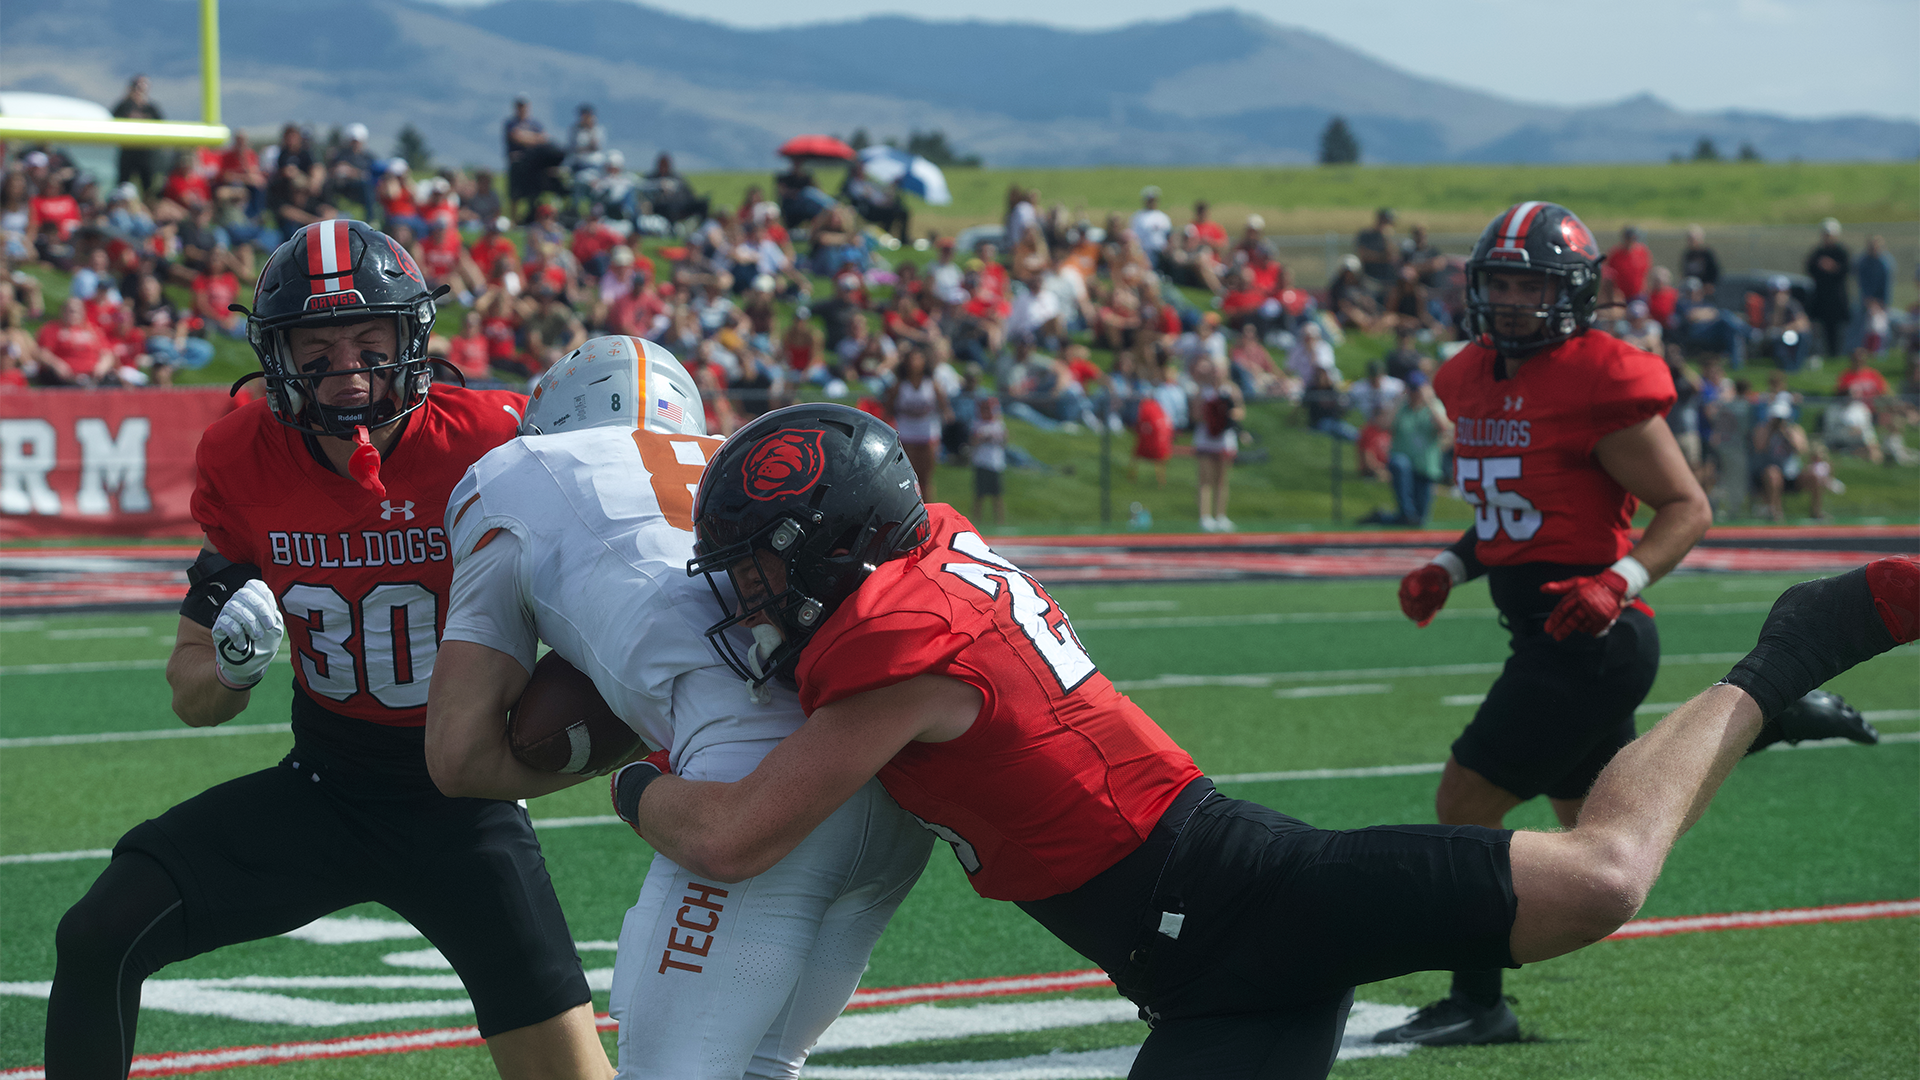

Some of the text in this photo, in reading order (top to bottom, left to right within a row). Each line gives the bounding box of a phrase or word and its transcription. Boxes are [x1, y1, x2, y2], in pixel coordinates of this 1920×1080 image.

[310, 293, 357, 310] DAWGS
[337, 413, 363, 421] Riddell
[611, 393, 621, 412] 8
[1456, 416, 1531, 447] BULLDOGS
[268, 526, 447, 568] BULLDOGS
[280, 581, 439, 709] 30
[658, 881, 729, 975] TECH
